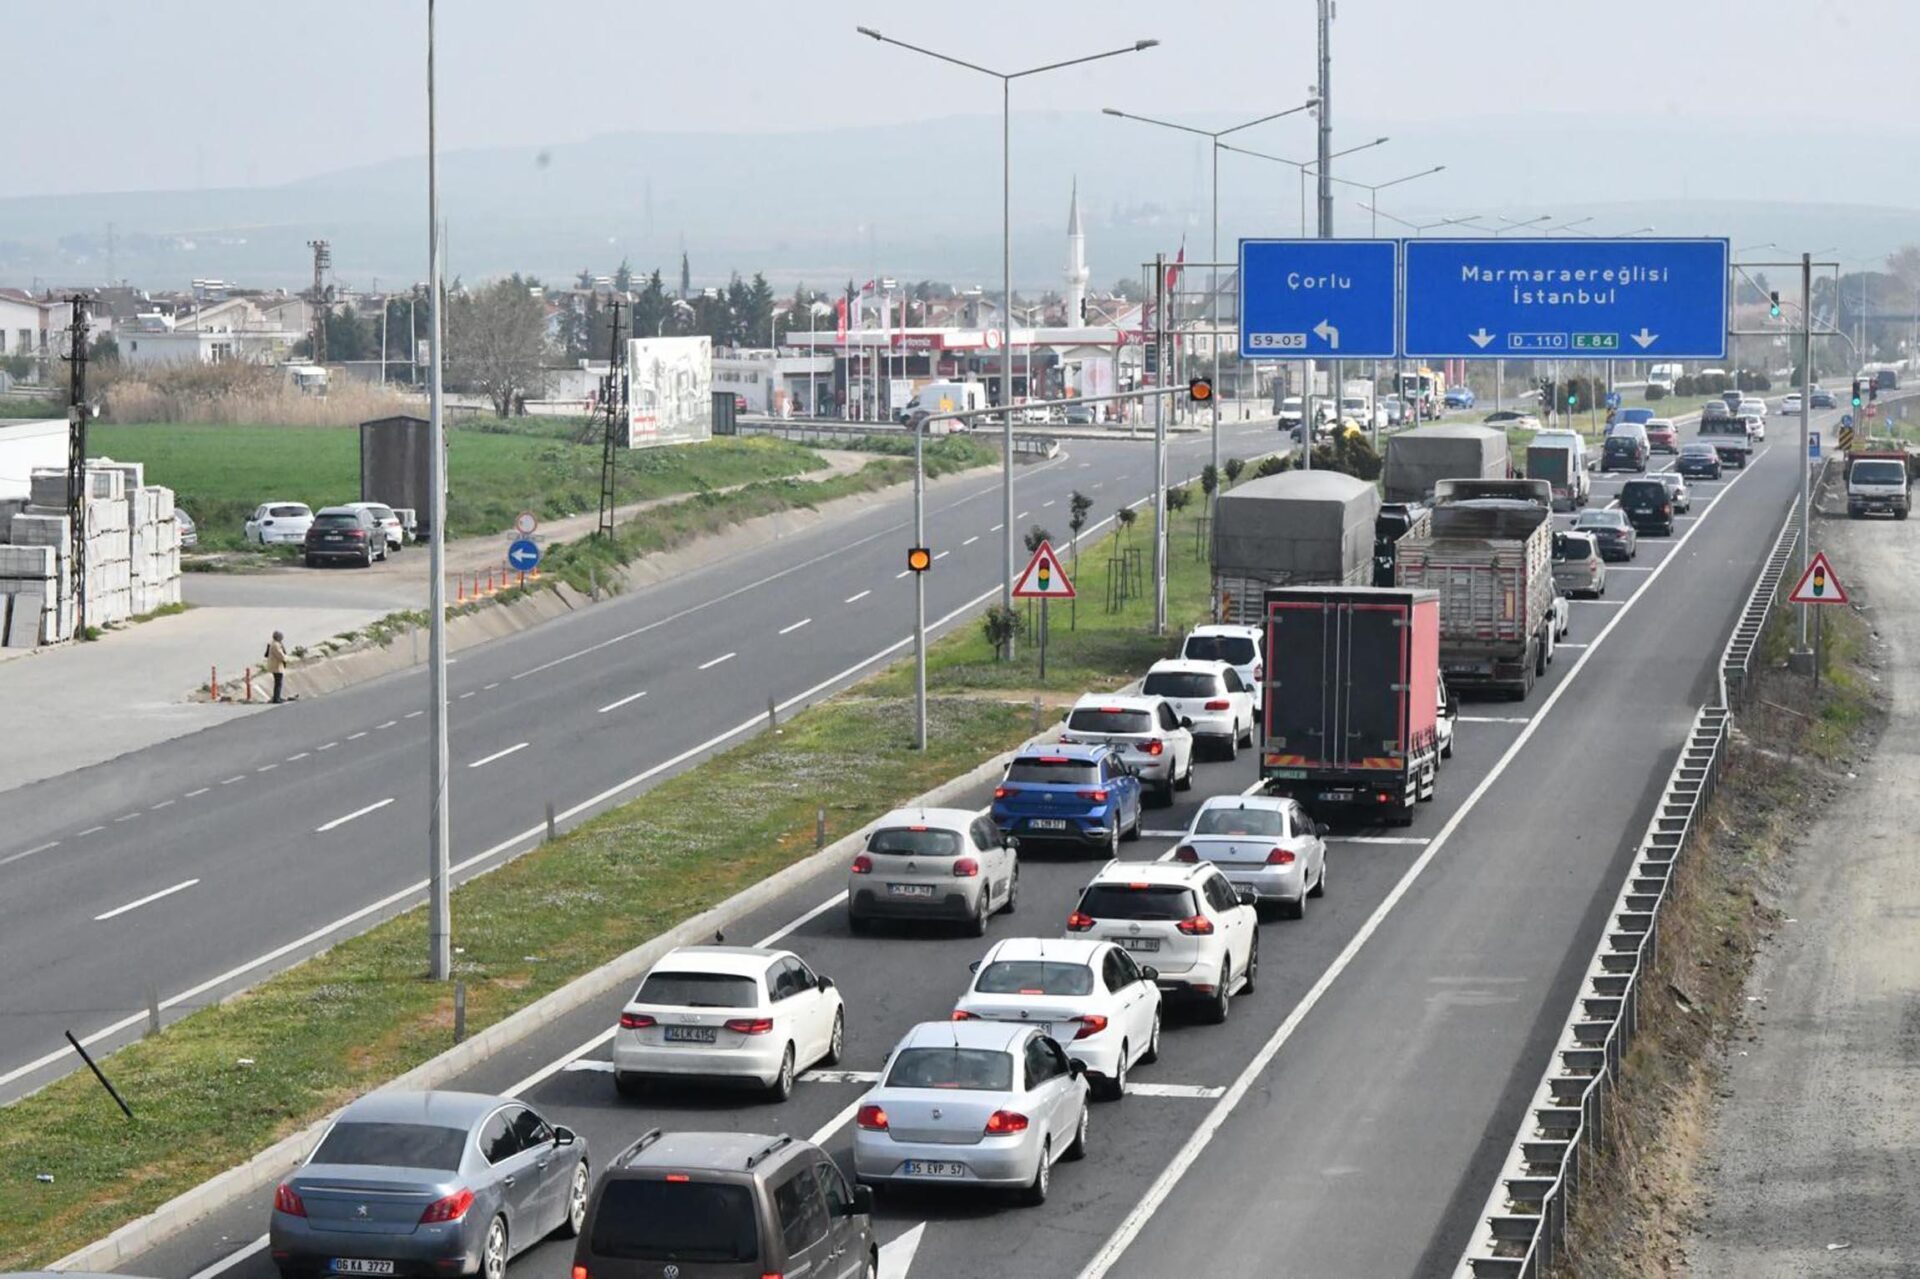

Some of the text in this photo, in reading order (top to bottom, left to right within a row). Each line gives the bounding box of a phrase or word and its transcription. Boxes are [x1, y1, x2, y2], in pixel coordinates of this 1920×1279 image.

[1287, 272, 1350, 290] Çorlu
[1462, 266, 1667, 285] Marmaraereğlisi
[1514, 285, 1614, 304] İstanbul
[1253, 335, 1303, 346] 59-05
[911, 1162, 922, 1173] 35
[950, 1163, 962, 1174] 57
[351, 1260, 363, 1271] KA
[367, 1261, 391, 1272] 3727
